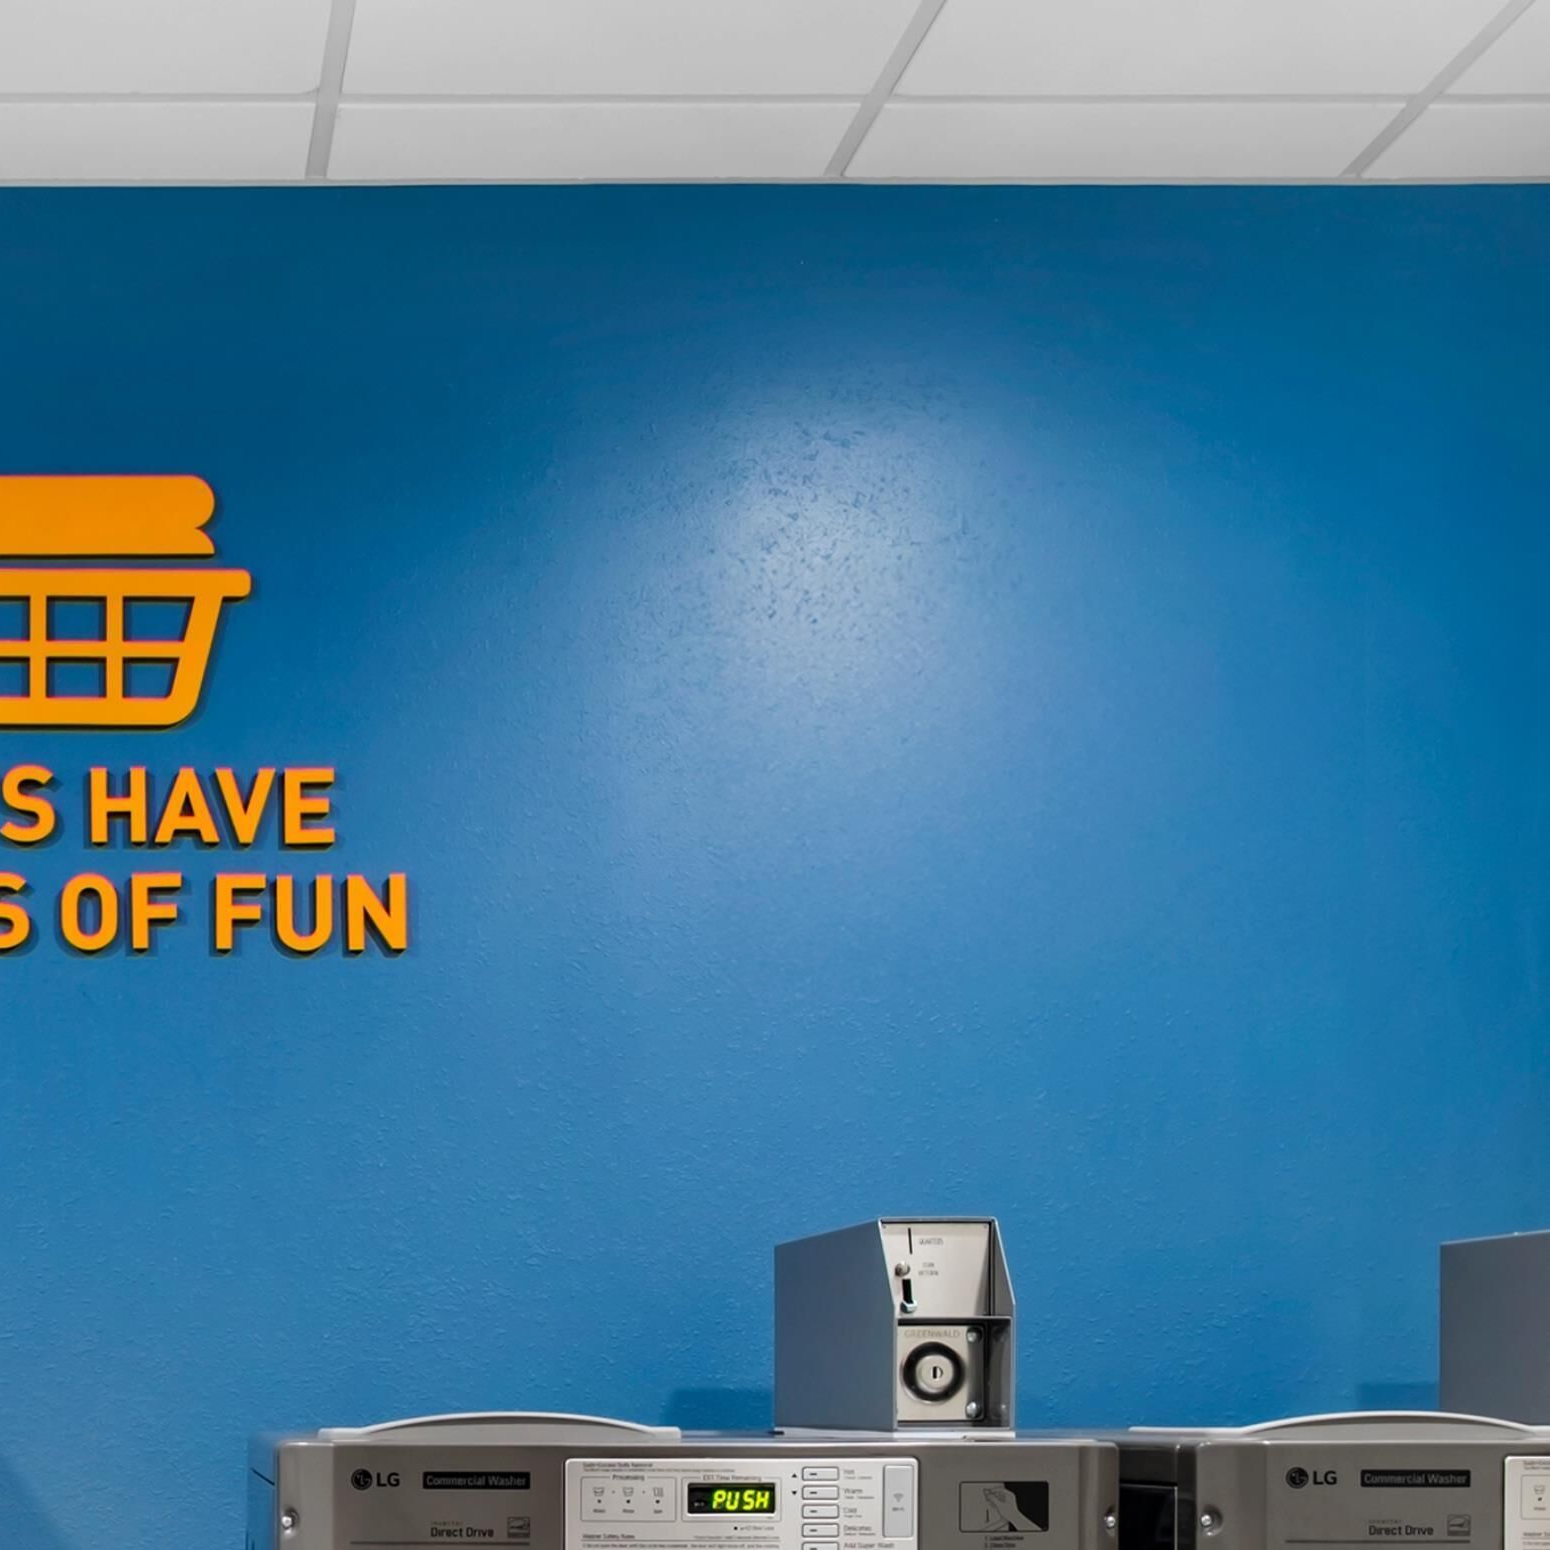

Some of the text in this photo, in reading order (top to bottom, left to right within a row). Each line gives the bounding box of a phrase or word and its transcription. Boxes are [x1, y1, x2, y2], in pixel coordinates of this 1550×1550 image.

[89, 765, 337, 848] HAVE
[60, 871, 183, 952] OF
[214, 872, 408, 953] FUN
[376, 1472, 526, 1487] LG Commercial Washer
[1313, 1470, 1467, 1486] LG Commercial Washer
[712, 1489, 770, 1511] PUSH
[430, 1526, 494, 1538] Direct Drive
[1368, 1525, 1434, 1536] Direct Drive
